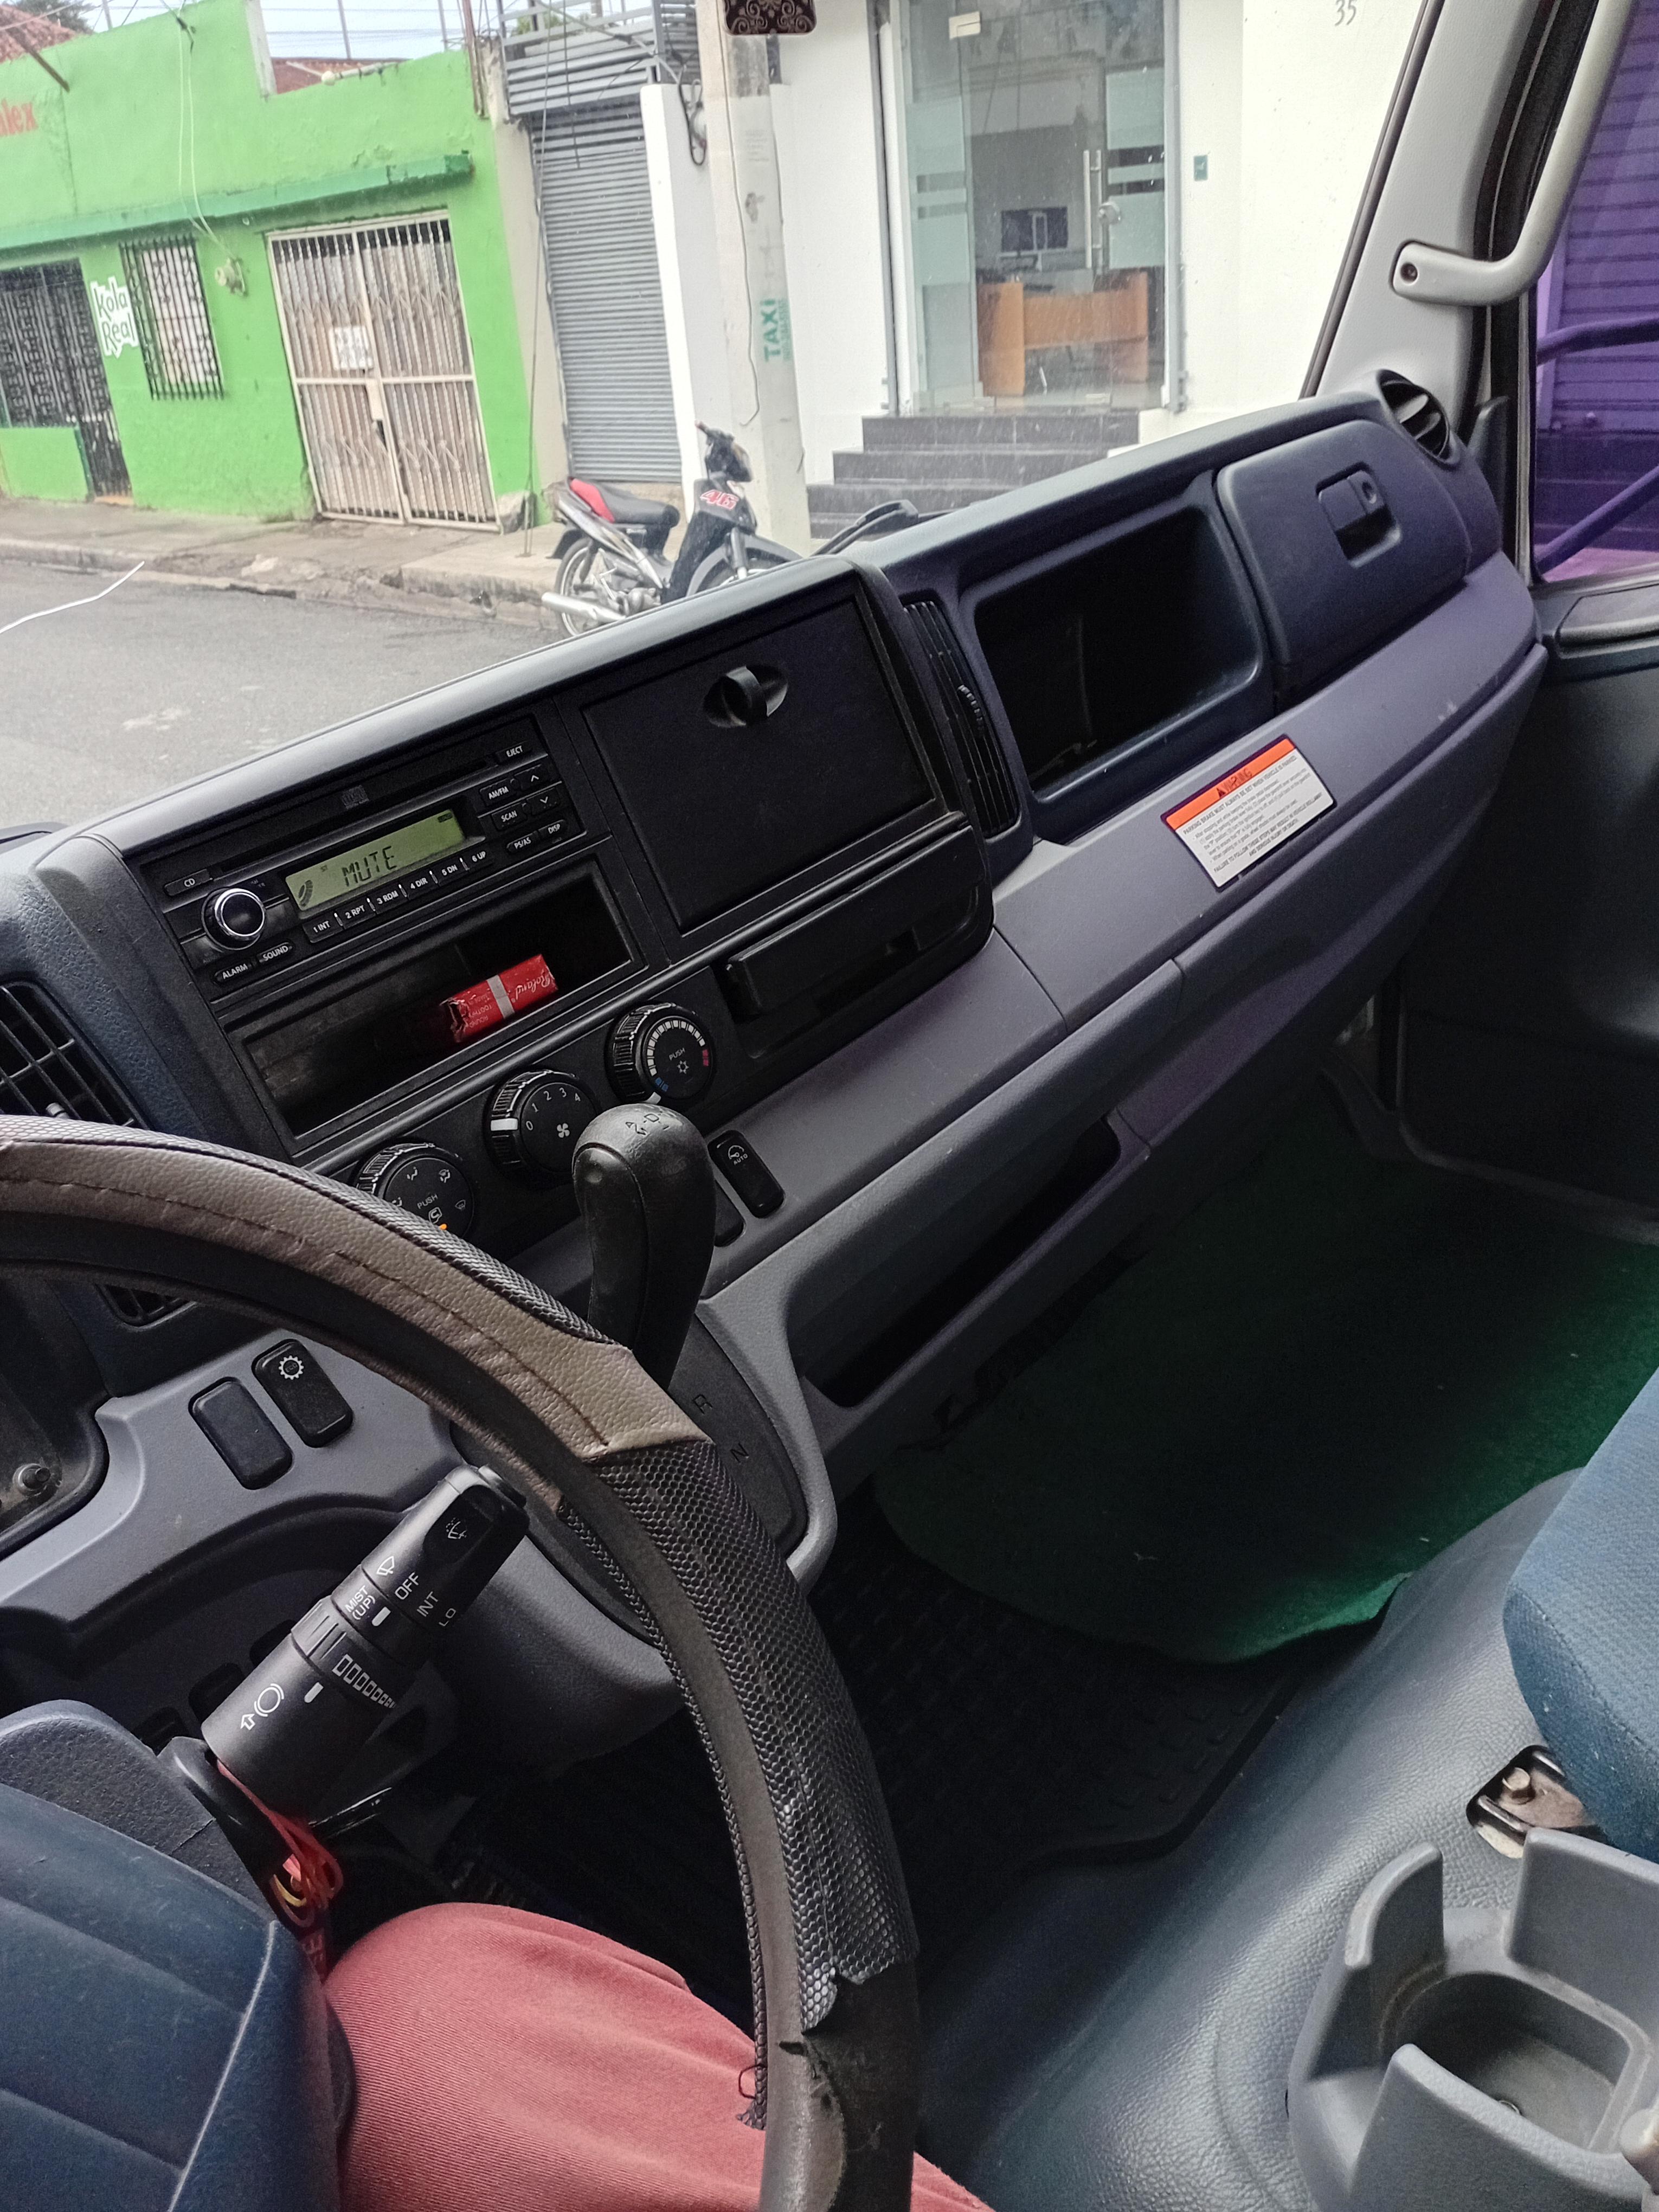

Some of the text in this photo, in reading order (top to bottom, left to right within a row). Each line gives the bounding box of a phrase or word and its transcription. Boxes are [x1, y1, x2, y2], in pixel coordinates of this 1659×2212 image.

[1335, 0, 1356, 26] 35
[94, 282, 128, 321] Kola
[102, 313, 135, 351] Real
[700, 489, 739, 510] 46
[506, 745, 523, 757] EJECT
[488, 786, 509, 799] AM/FM
[501, 810, 517, 822] SCAN
[548, 824, 561, 834] DISP
[514, 837, 531, 849] PS/AS
[477, 851, 486, 860] UP
[341, 846, 397, 887] MUTE
[447, 864, 458, 874] DN
[184, 878, 195, 887] CD
[415, 877, 428, 887] DIR
[383, 890, 399, 902] RDM
[351, 905, 365, 916] RPT
[318, 921, 330, 931] INT
[262, 945, 288, 961] SOUND
[222, 963, 248, 979] ALARM
[669, 1047, 685, 1060] PUSH
[543, 1090, 552, 1101] 2
[559, 1087, 567, 1097] 3
[575, 1093, 581, 1102] 4
[532, 1103, 539, 1113] 1
[734, 1153, 748, 1166] AUTO
[417, 1194, 438, 1209] PUSH
[730, 1443, 749, 1463] N
[395, 1572, 419, 1600] OFF
[344, 1585, 369, 1612] MIST
[416, 1591, 439, 1617] INT
[352, 1595, 376, 1620] (UP)
[439, 1607, 456, 1626] LO
